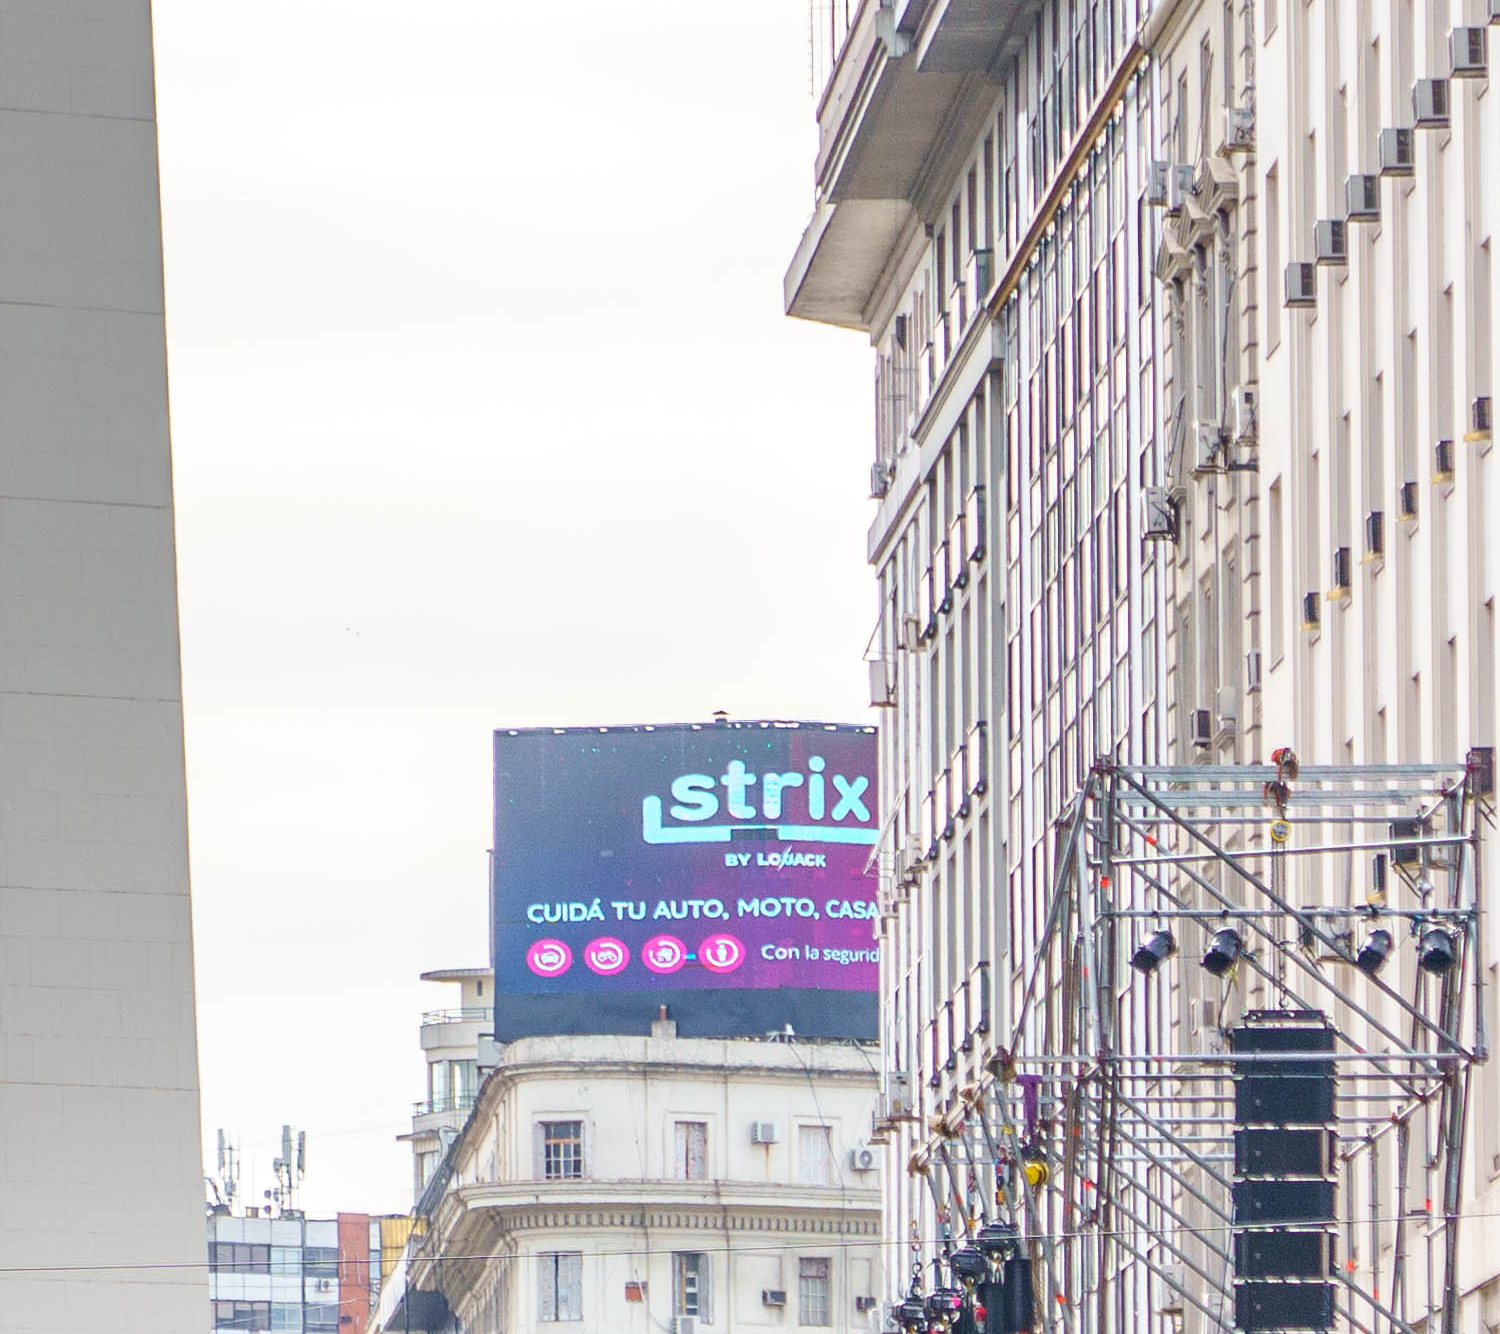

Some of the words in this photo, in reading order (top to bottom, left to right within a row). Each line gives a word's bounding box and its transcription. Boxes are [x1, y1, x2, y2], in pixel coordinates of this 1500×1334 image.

[669, 755, 871, 822] strix
[724, 853, 751, 867] BY
[526, 898, 605, 923] CUIDÁ
[611, 901, 646, 921] TU
[652, 898, 730, 922] AUTO,
[737, 897, 820, 921] MOTO,
[761, 943, 800, 961] Con
[804, 944, 819, 960] la
